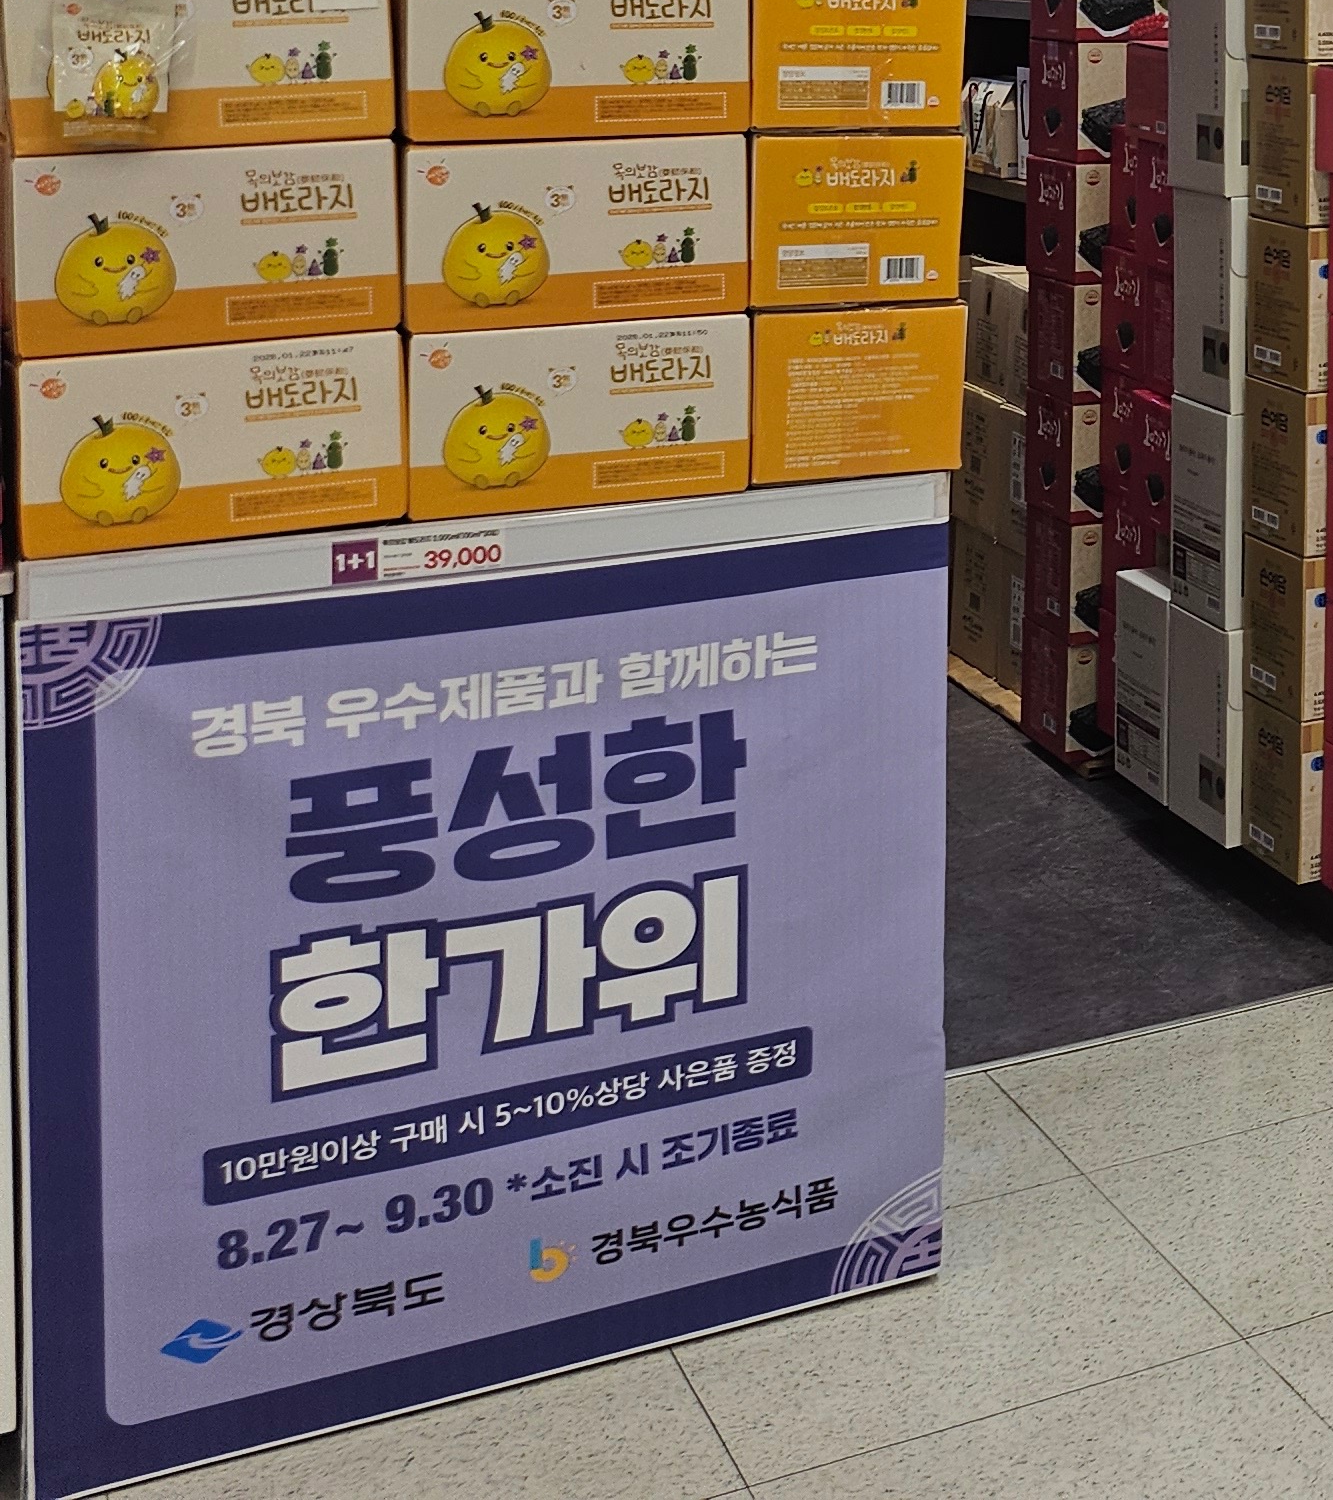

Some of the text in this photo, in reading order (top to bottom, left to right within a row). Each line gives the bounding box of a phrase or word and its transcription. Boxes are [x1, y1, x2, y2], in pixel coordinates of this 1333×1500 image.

[239, 183, 355, 213] 배도라지
[607, 177, 711, 206] 배도라지
[825, 167, 896, 189] 배도라지
[245, 376, 358, 410] 배도라지
[610, 354, 713, 385] 배도라지
[335, 543, 502, 573] 1+1 39,000
[191, 630, 818, 760] 경북 우수제품과 함께하는
[287, 709, 748, 904] 풍성한
[271, 865, 748, 1102] 한가위
[220, 1040, 799, 1187] 10만원이상 구매 시 5~10%상당 사은품 증정
[216, 1197, 366, 1273] 8.27~
[384, 1174, 495, 1235] 9.30
[616, 1143, 650, 1182] 시
[662, 1110, 799, 1176] 조기종료
[590, 1178, 839, 1266] 경북우수농식품
[250, 1271, 446, 1343] 경상북도
